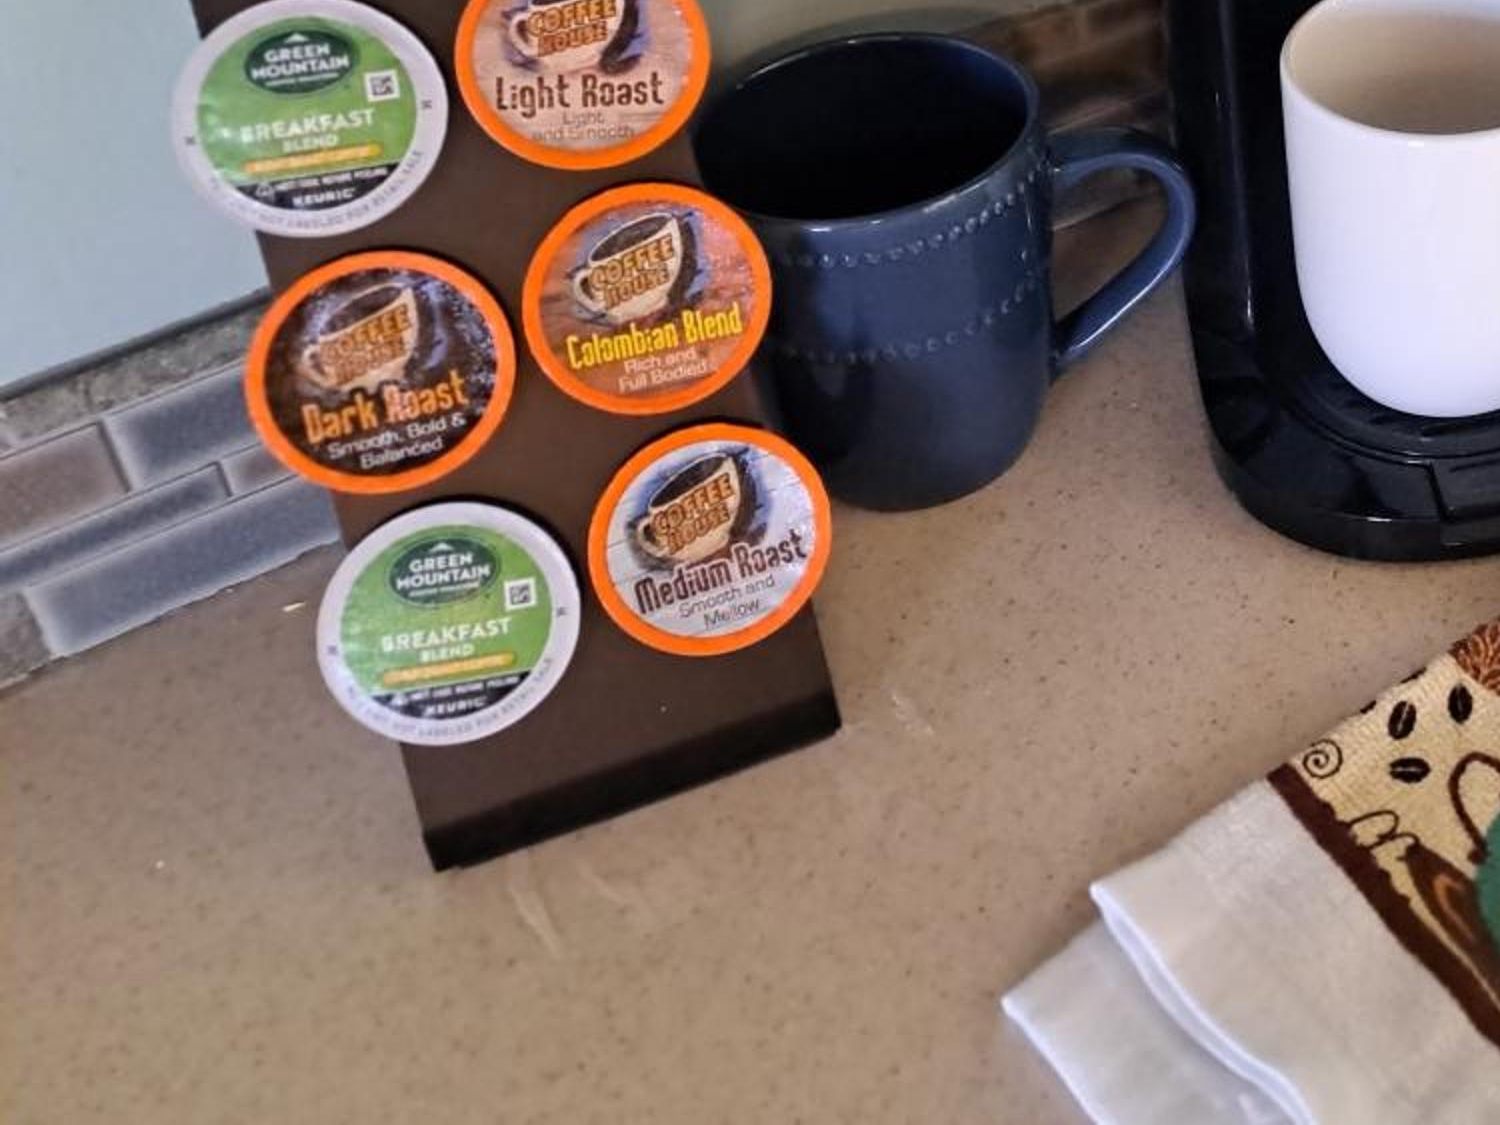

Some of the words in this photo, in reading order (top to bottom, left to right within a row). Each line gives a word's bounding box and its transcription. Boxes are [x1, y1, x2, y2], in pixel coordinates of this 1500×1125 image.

[263, 43, 331, 62] GREEN
[537, 21, 608, 58] HOUSE
[251, 55, 349, 80] MOUNTAIN
[496, 74, 570, 118] Light
[581, 72, 665, 108] Roast
[240, 108, 375, 143] BREAKFAST
[283, 134, 339, 153] BLEND
[588, 232, 675, 291] COFFEE
[602, 263, 669, 311] HOUSE
[320, 302, 410, 359] COFFEE
[566, 321, 679, 370] Colombian
[681, 300, 743, 345] Blend
[618, 373, 648, 394] Full
[651, 359, 706, 385] Bodied
[623, 353, 662, 374] Rich
[302, 392, 378, 444] Dark
[383, 368, 469, 423] Roast
[407, 416, 447, 439] Bold
[451, 412, 467, 426] &
[359, 437, 444, 470] Balanced
[652, 472, 734, 534] COFFEE
[667, 502, 730, 556] HOUSE
[396, 564, 490, 590] MOUNTAIN
[409, 552, 473, 573] GREEN
[634, 561, 732, 614] Medium
[735, 528, 806, 578] Roast
[679, 586, 742, 618] Smooth
[745, 575, 775, 594] and
[703, 600, 760, 628] Mellow
[381, 617, 512, 652] BREAKFAST
[419, 643, 475, 663] BLEND
